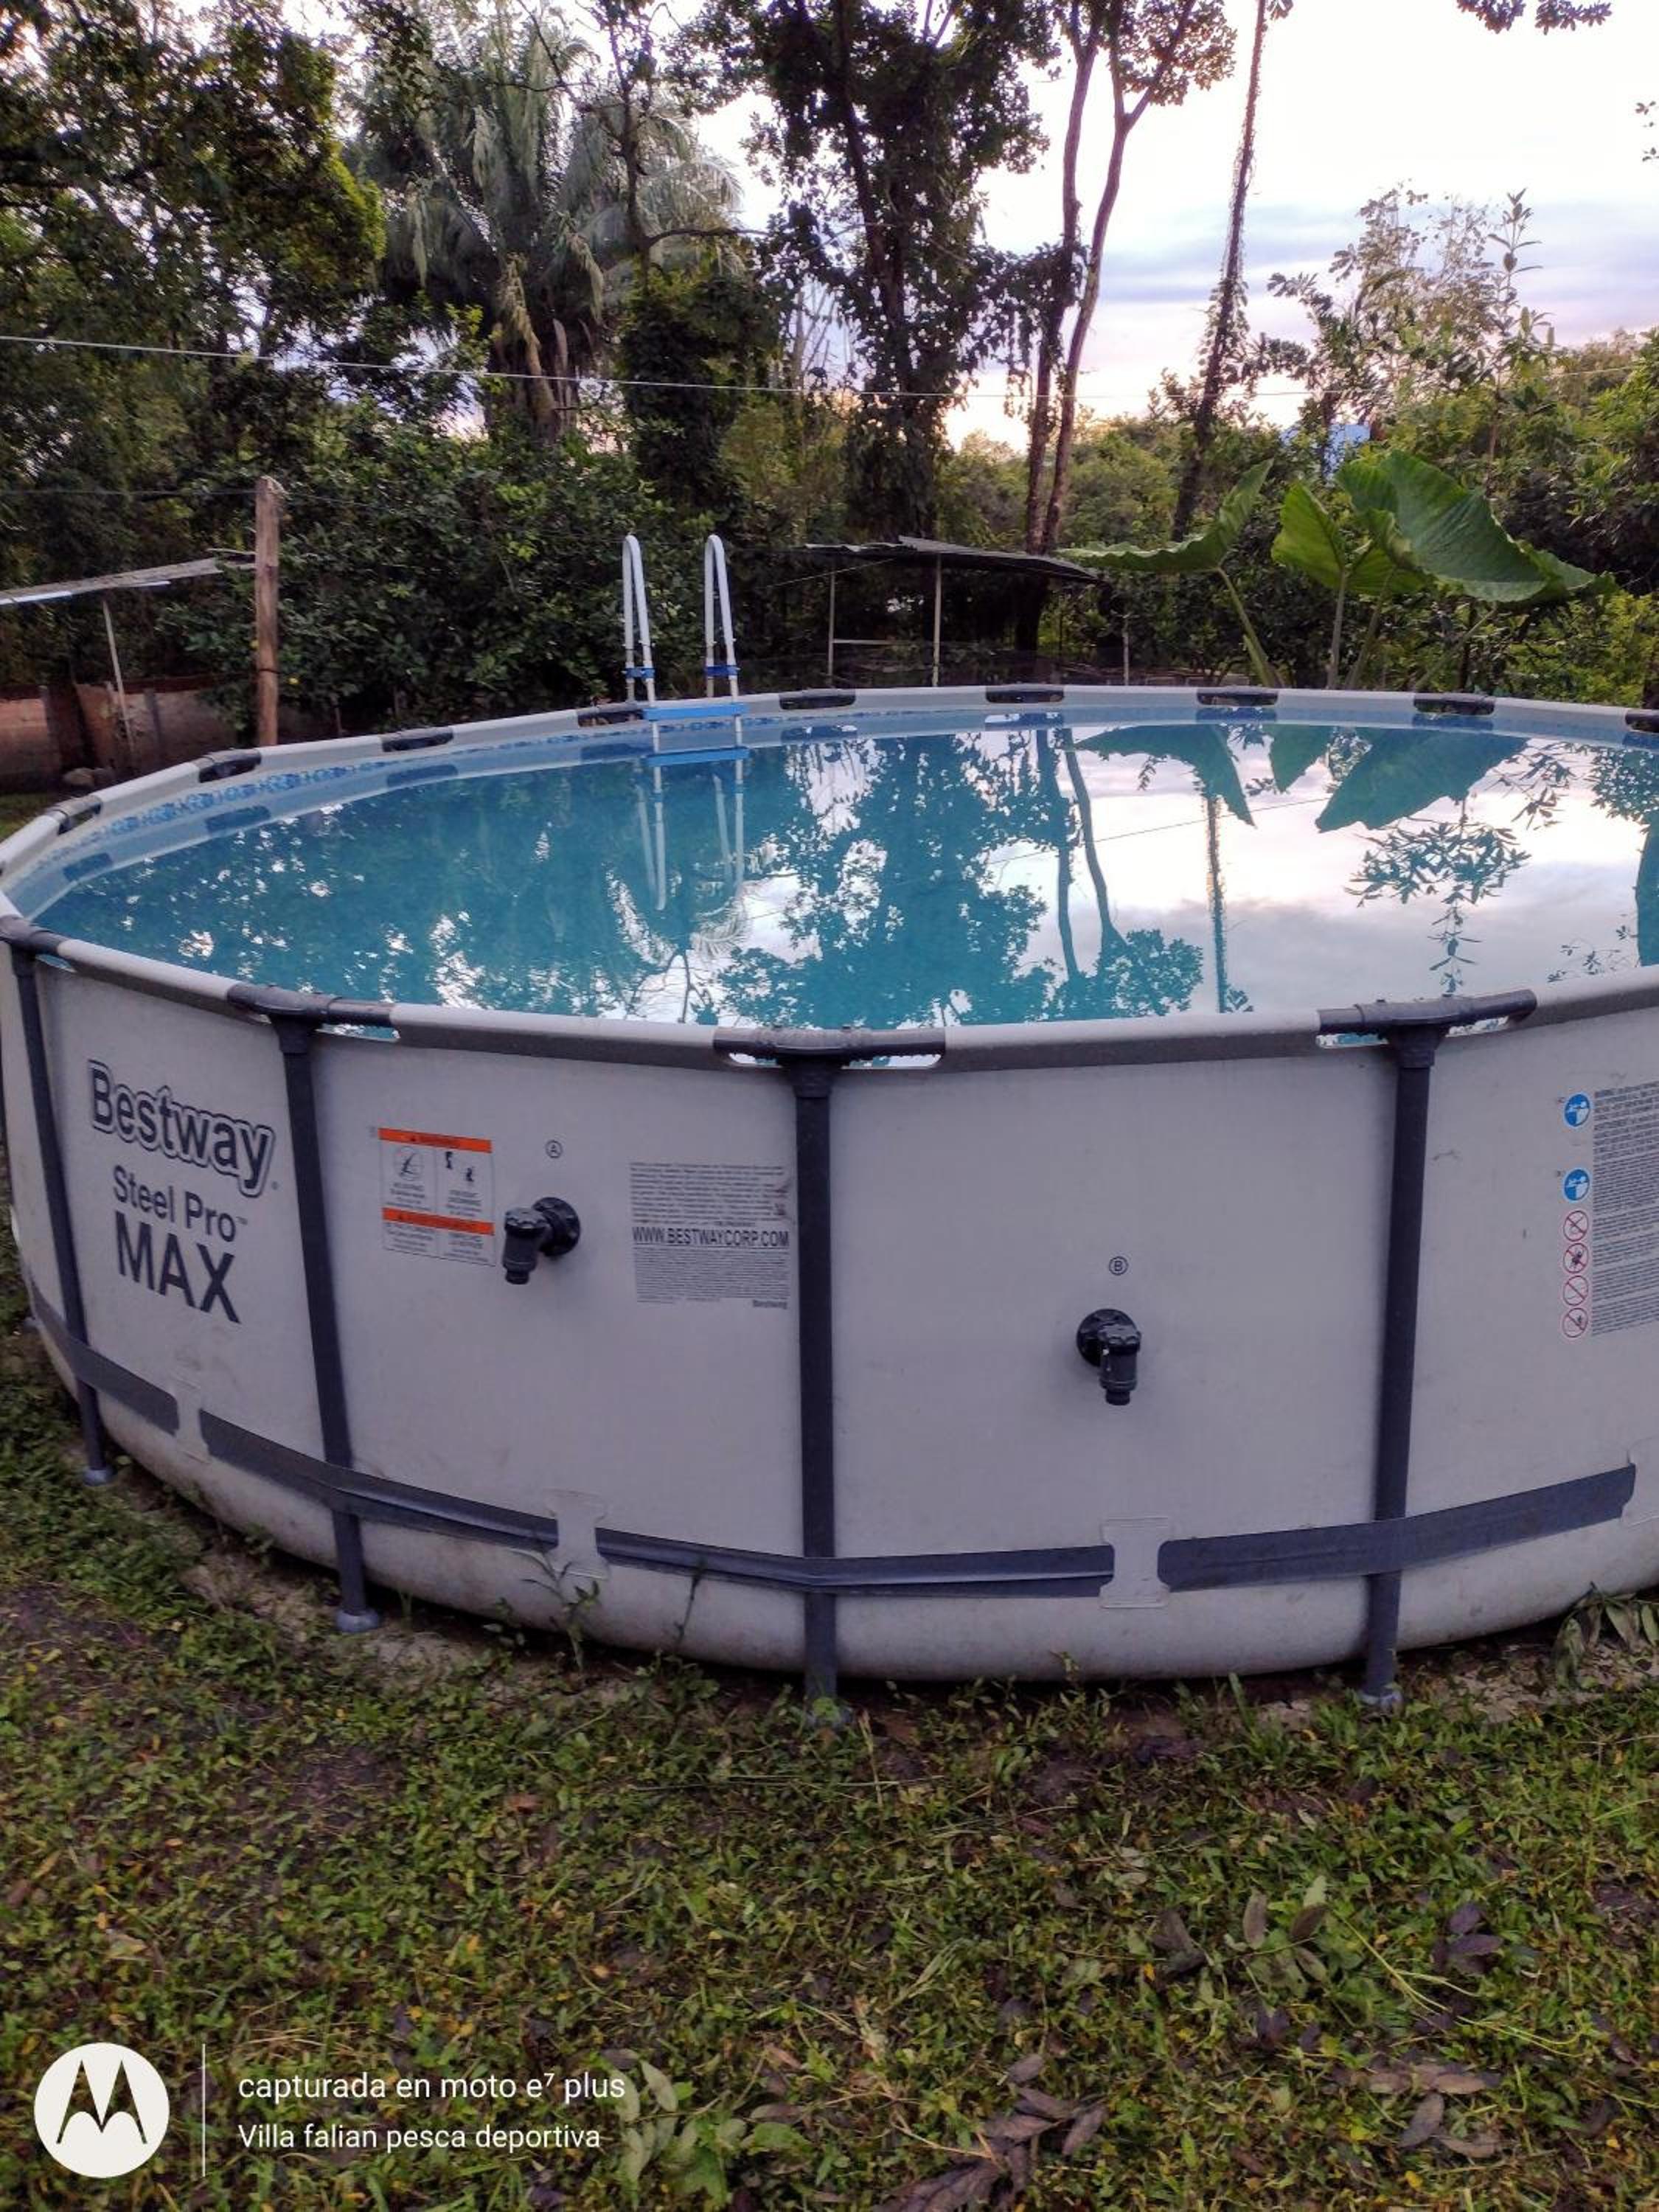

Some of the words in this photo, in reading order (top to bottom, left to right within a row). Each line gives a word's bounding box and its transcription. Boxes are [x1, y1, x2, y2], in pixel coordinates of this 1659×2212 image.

[88, 1060, 275, 1197] Bestway
[114, 1164, 175, 1223] Steel
[184, 1191, 237, 1242] Pro
[115, 1209, 242, 1324] MAX
